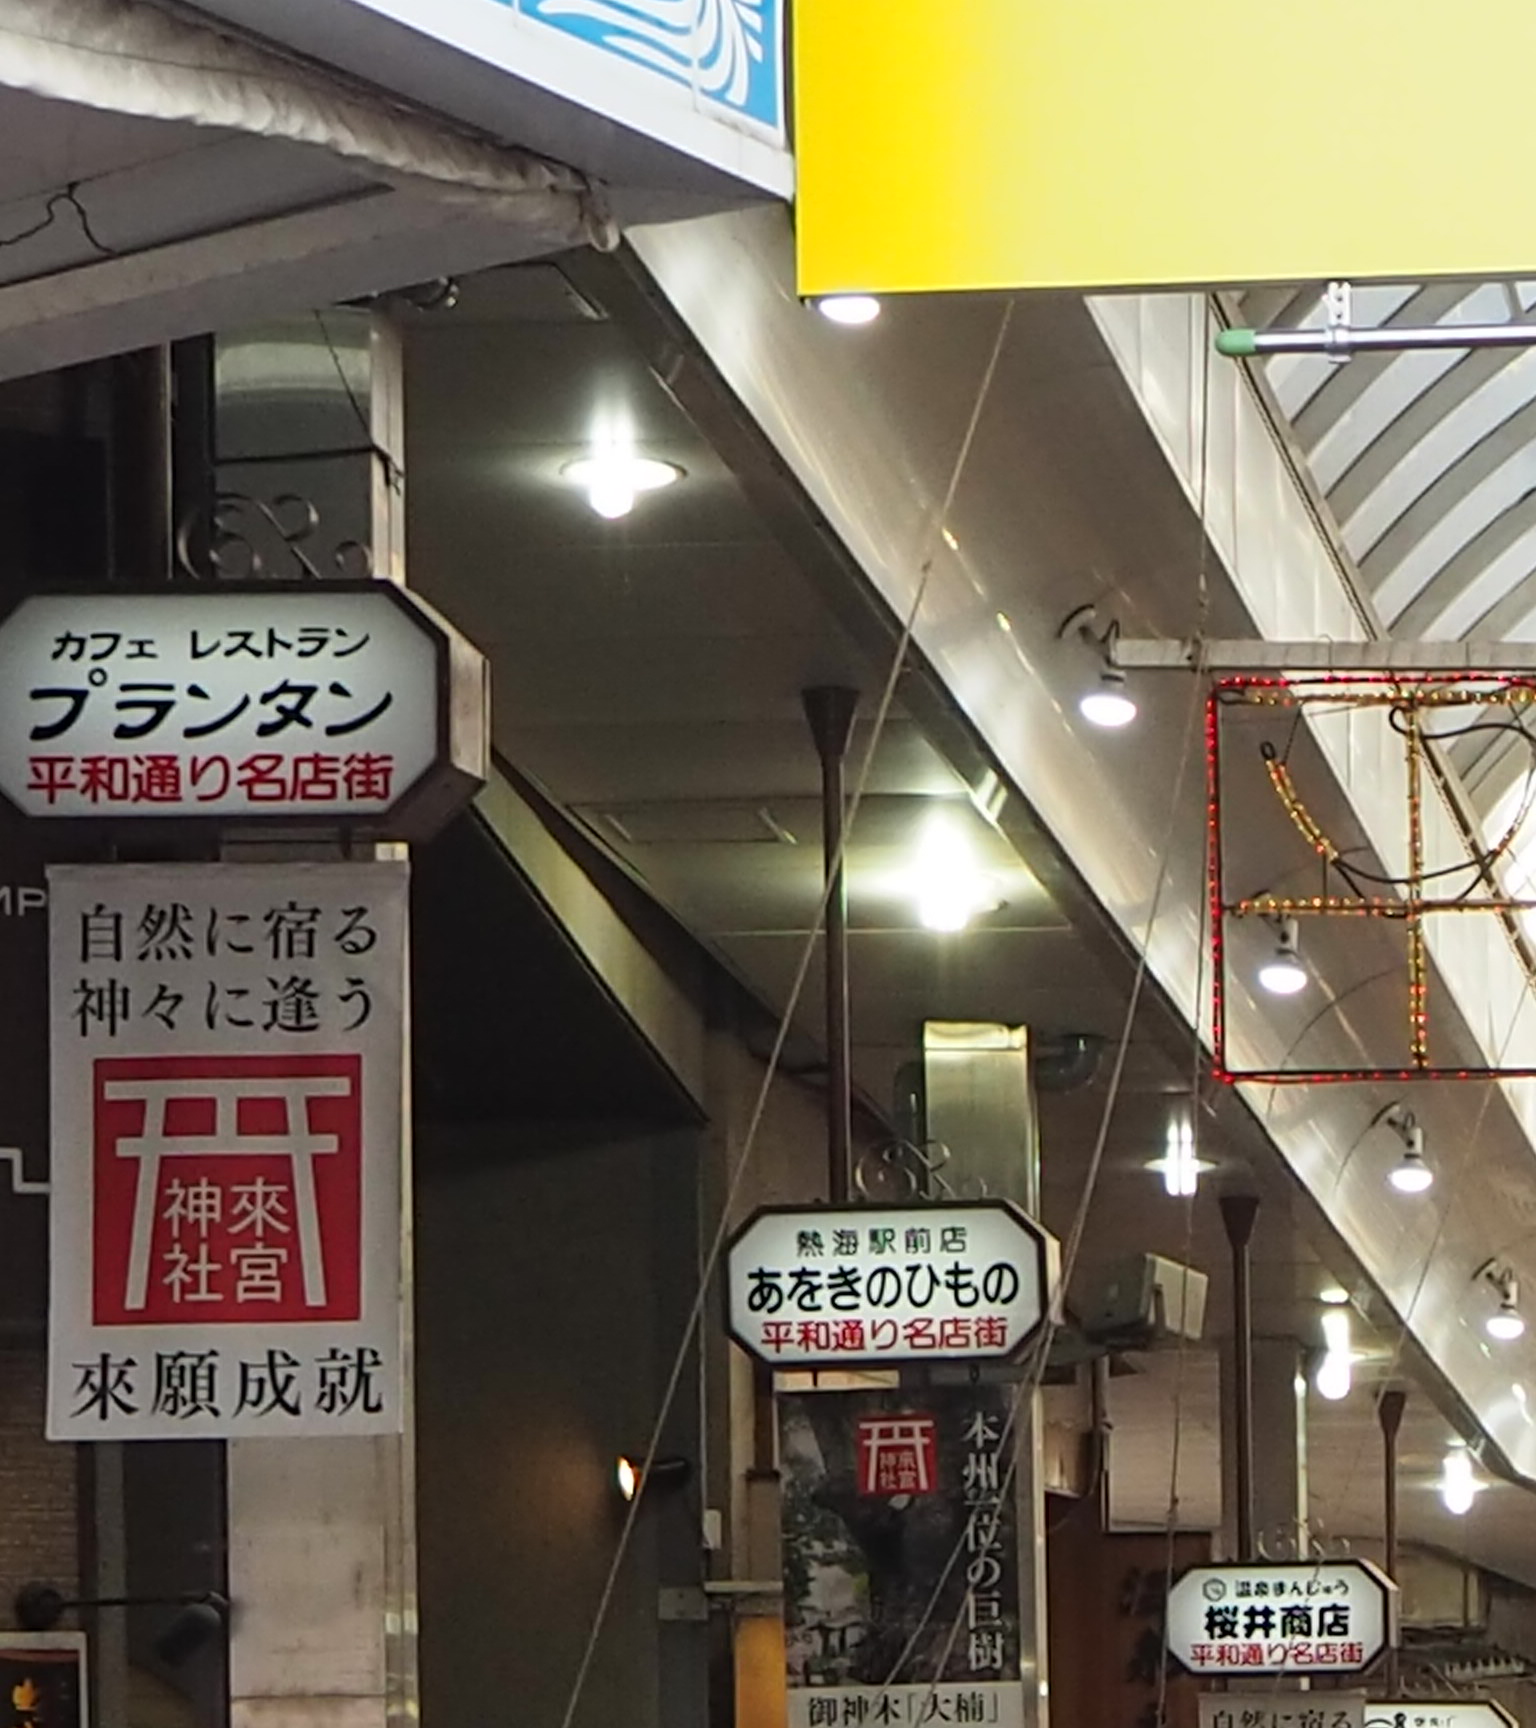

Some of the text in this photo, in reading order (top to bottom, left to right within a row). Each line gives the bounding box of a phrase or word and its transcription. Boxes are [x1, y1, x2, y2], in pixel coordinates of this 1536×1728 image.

[50, 626, 370, 661] カフェ レストラン
[28, 668, 394, 741] プランタン
[27, 754, 395, 803] 平和通り名店街
[78, 903, 378, 962] 自然に宿る
[72, 976, 374, 1037] 神々に逢う
[797, 1228, 967, 1257] 熱海駅前店
[747, 1262, 1019, 1314] あをきのひもの
[760, 1317, 1007, 1350] 平和通り名店街
[1234, 1579, 1350, 1597] 温泉まんじゅう
[1204, 1604, 1351, 1640] 桜井商店
[1190, 1642, 1364, 1666] 平和通り名店街
